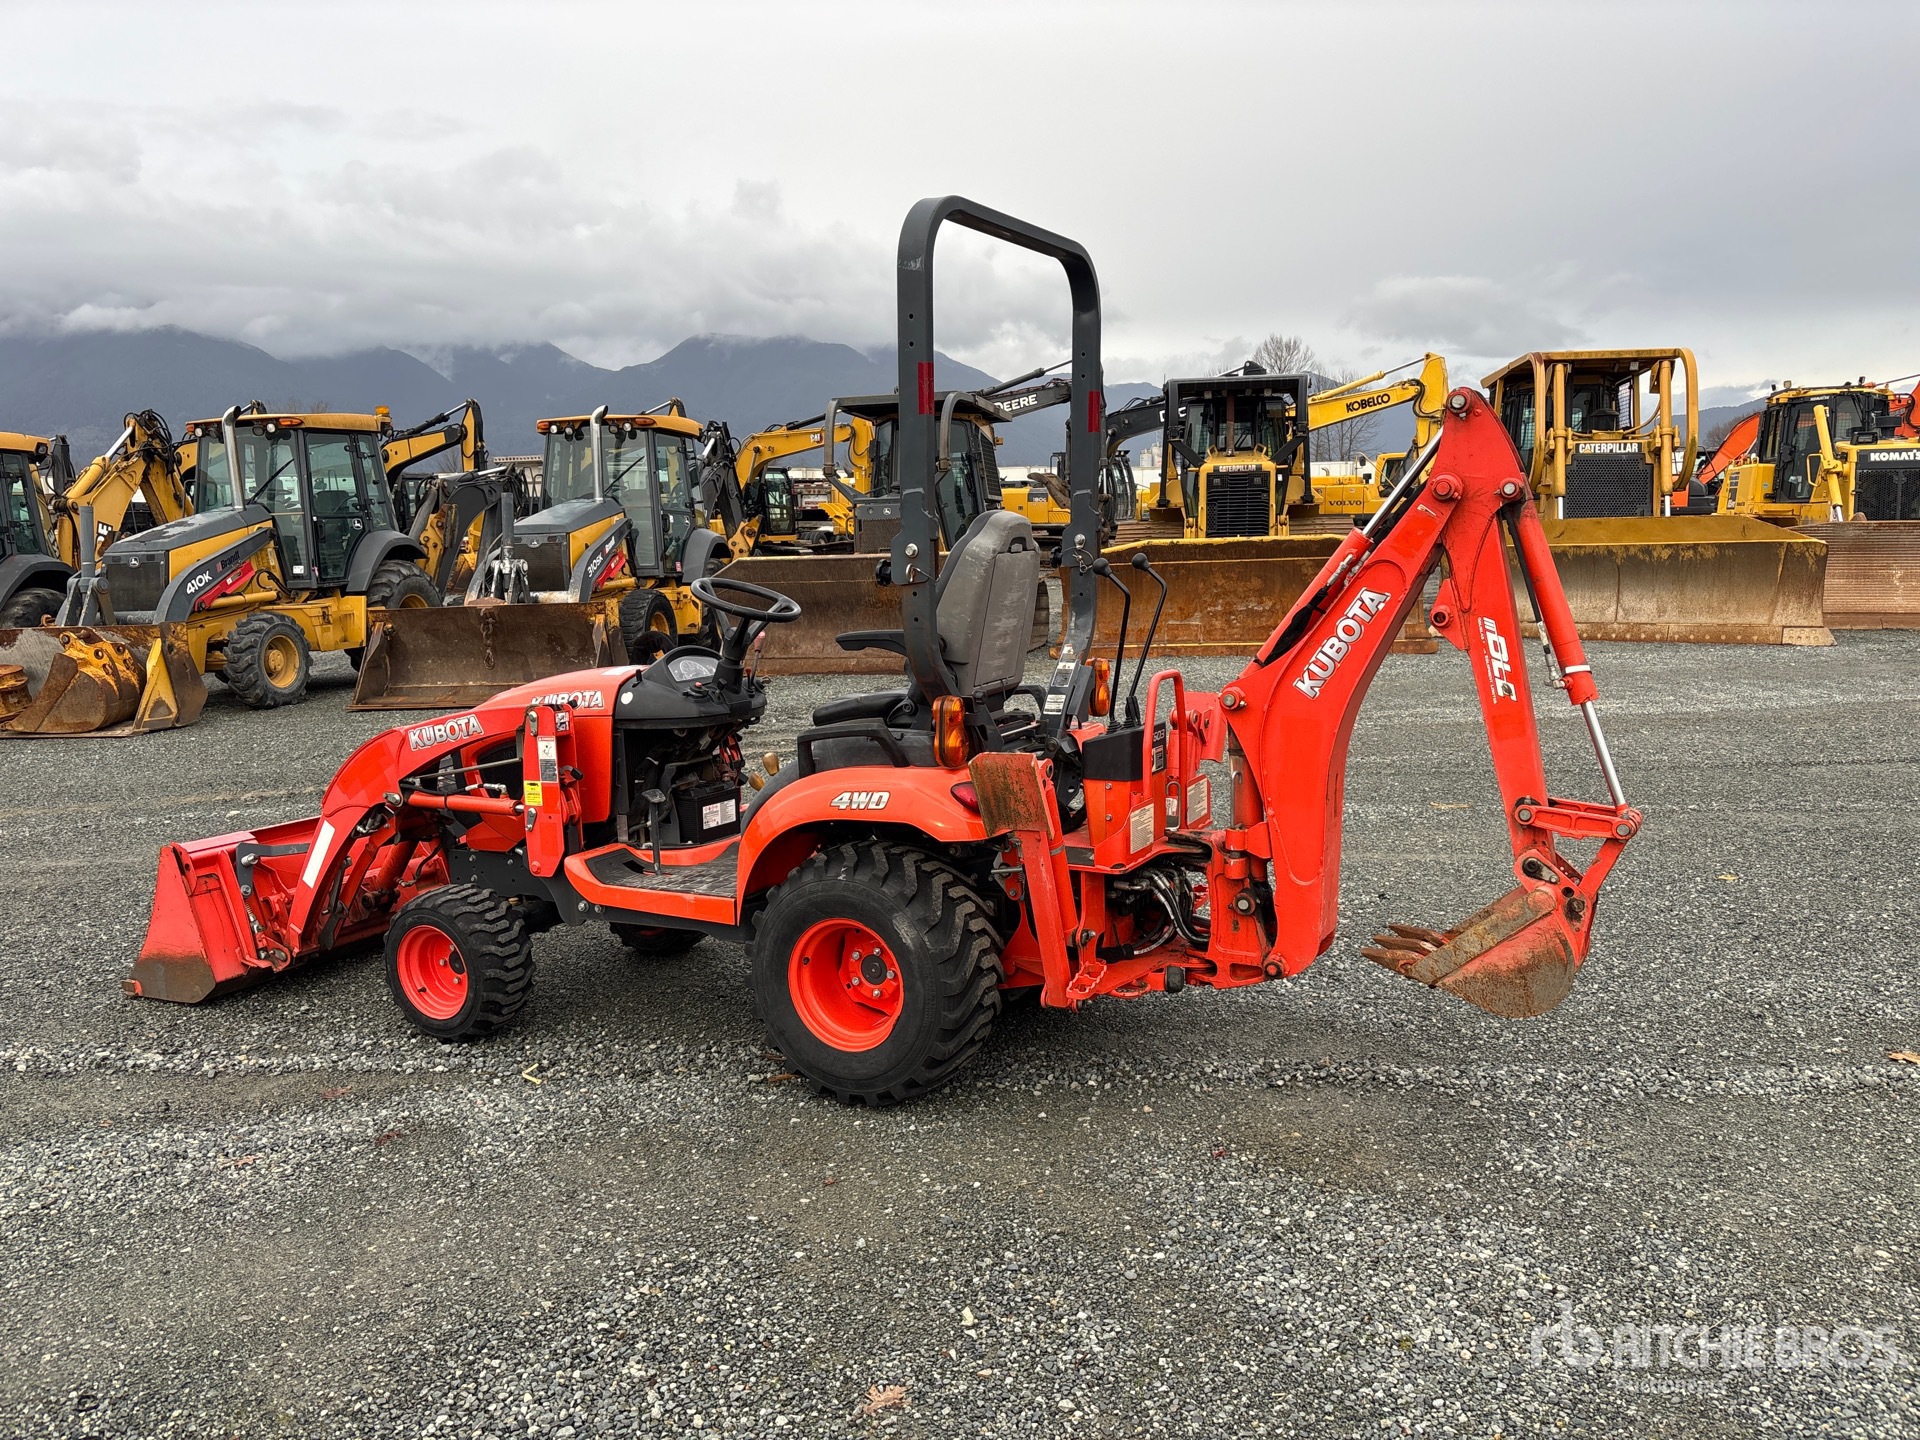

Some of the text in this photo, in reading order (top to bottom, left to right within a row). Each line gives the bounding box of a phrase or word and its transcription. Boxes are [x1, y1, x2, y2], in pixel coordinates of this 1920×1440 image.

[1346, 393, 1390, 413] KOBELCO
[1579, 442, 1639, 453] CATERPILLAR
[1219, 464, 1257, 473] CATERPILLAR
[186, 570, 213, 595] 410K
[221, 550, 241, 570] Brandt
[1293, 587, 1392, 700] KUBOTA
[408, 714, 484, 751] KUBOTA
[829, 791, 891, 810] 4WD
